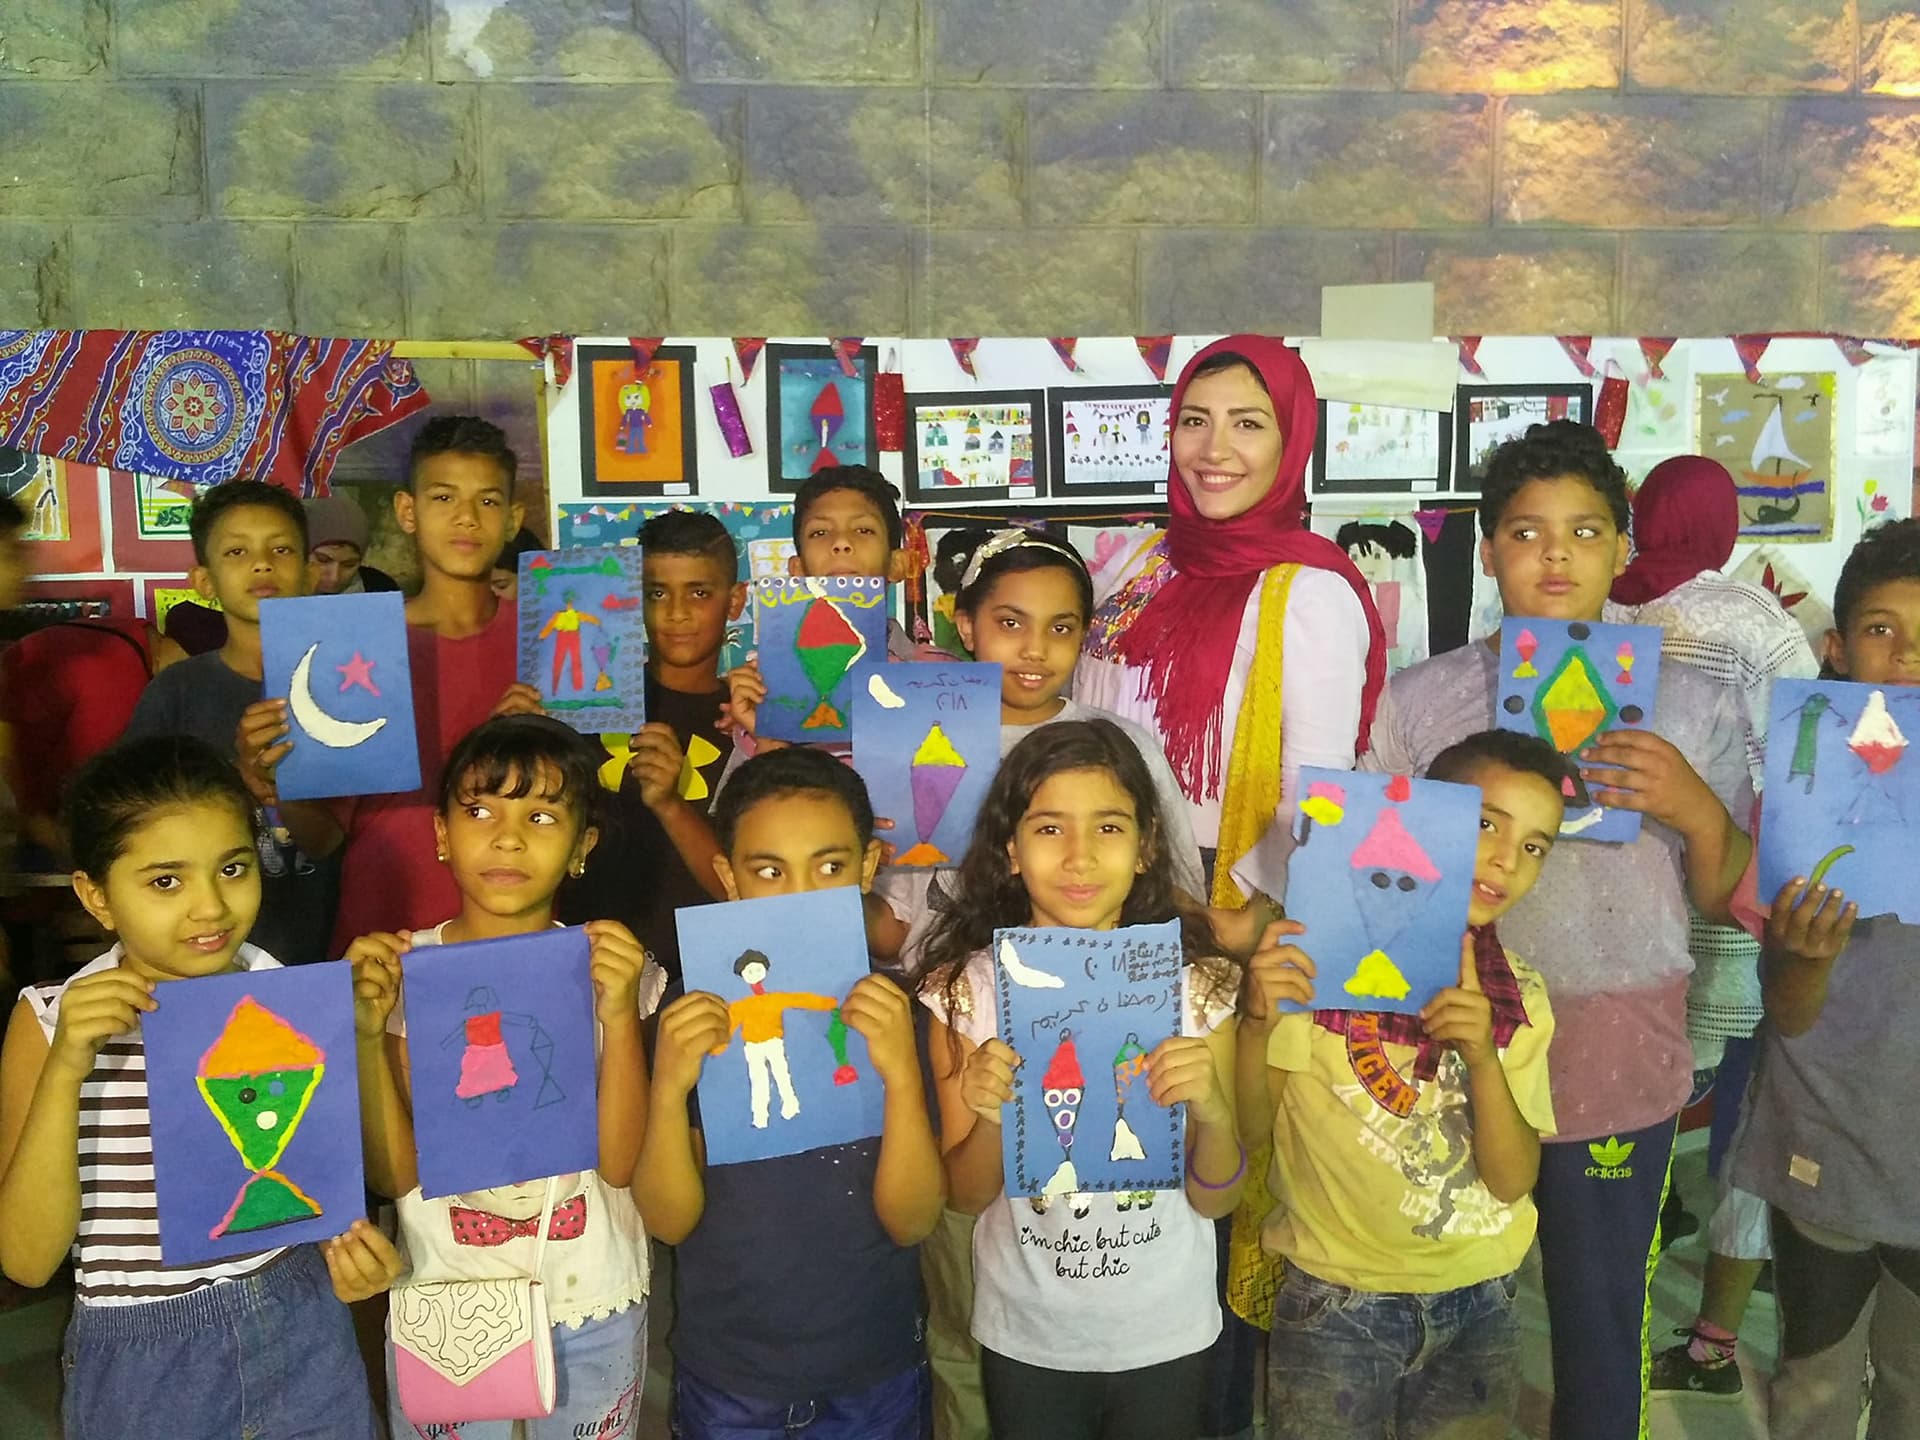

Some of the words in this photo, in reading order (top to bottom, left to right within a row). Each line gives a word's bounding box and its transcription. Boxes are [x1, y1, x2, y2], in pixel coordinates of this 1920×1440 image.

[1031, 1000, 1090, 1040] كريم
[1584, 1167, 1633, 1180] adidas
[1020, 1226, 1051, 1250] i'm
[1095, 1223, 1130, 1250] but
[1055, 1254, 1089, 1280] but
[1092, 1252, 1131, 1277] chic
